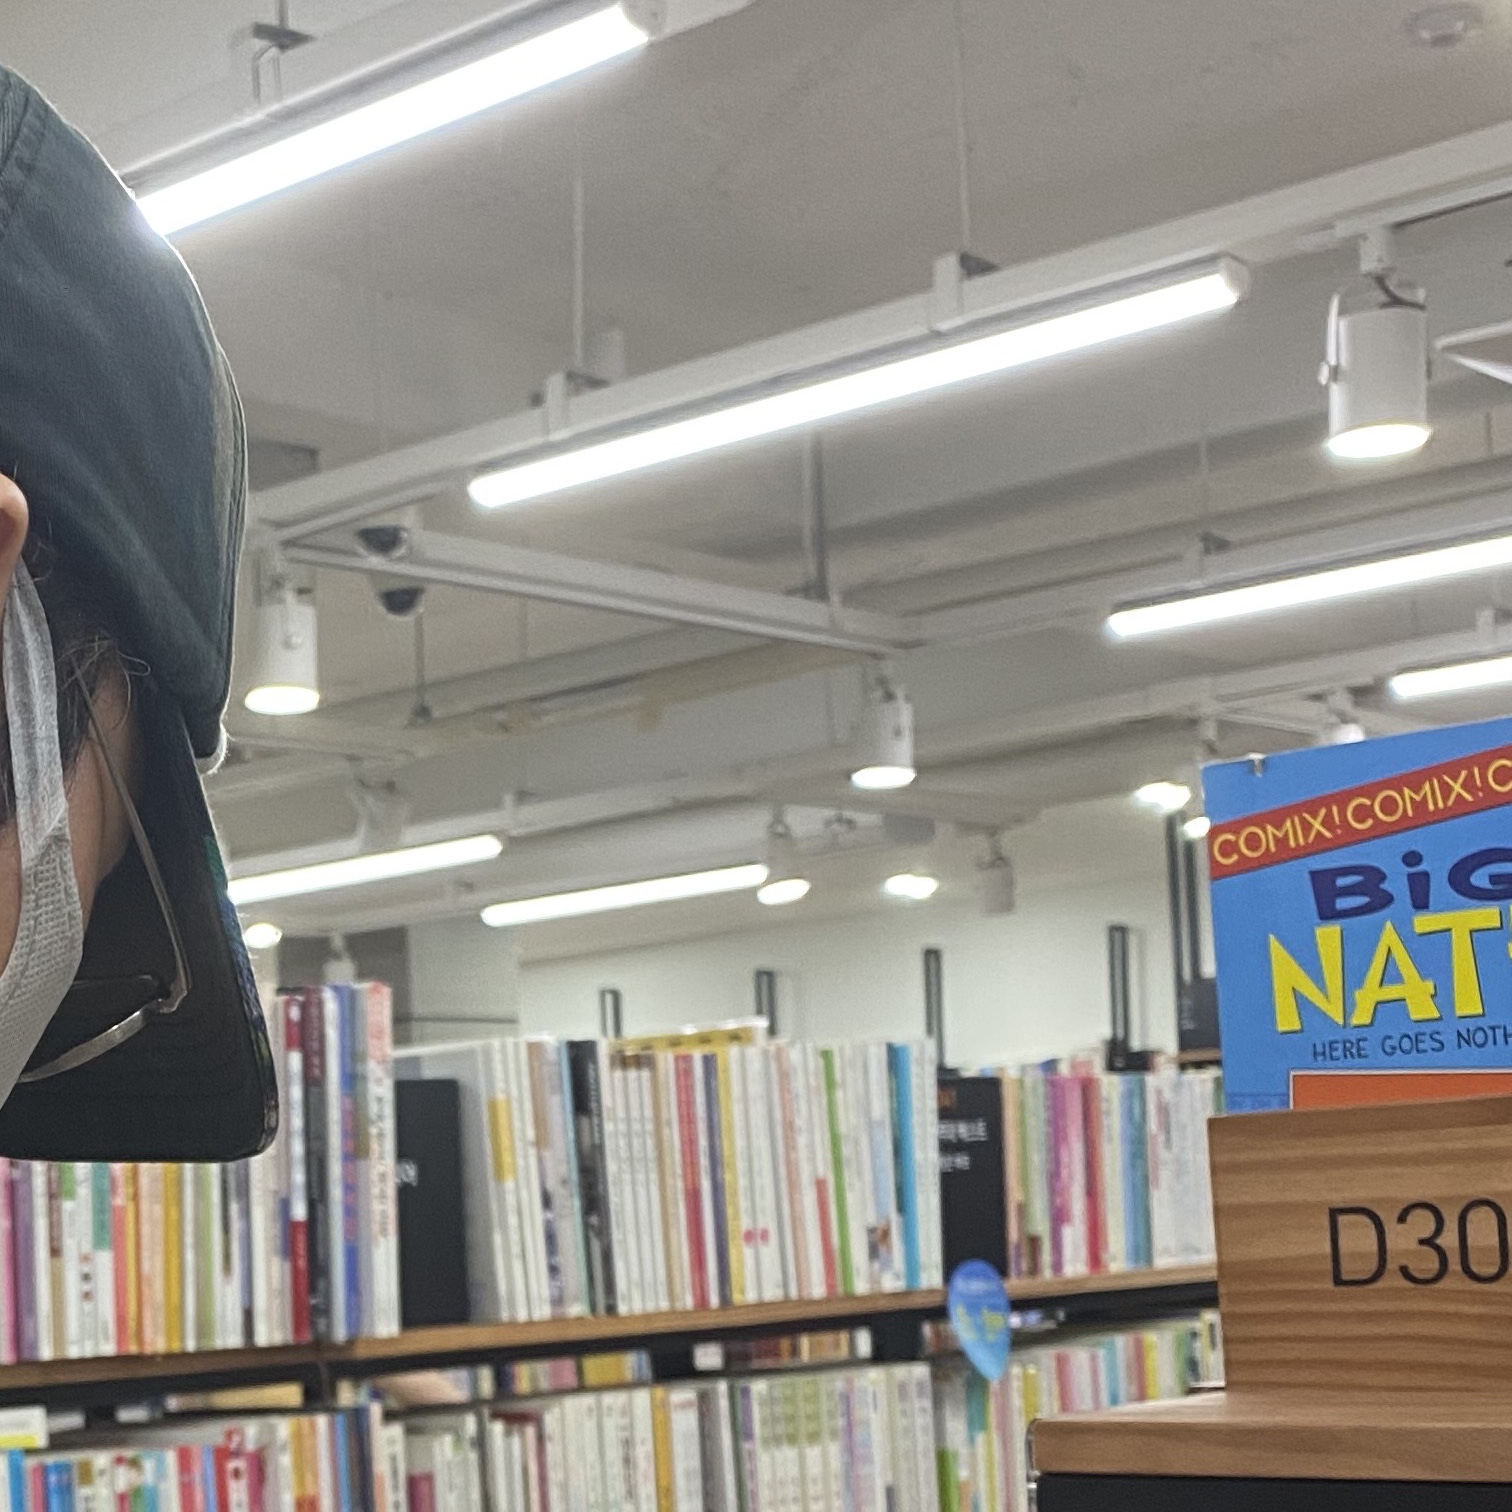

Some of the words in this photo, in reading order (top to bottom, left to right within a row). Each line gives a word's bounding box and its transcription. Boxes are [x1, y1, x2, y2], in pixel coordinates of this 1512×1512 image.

[1268, 905, 1512, 1034] NAT
[1313, 1038, 1369, 1062] HERE
[1381, 1030, 1445, 1057] GOES
[1328, 1198, 1509, 1288] D30
